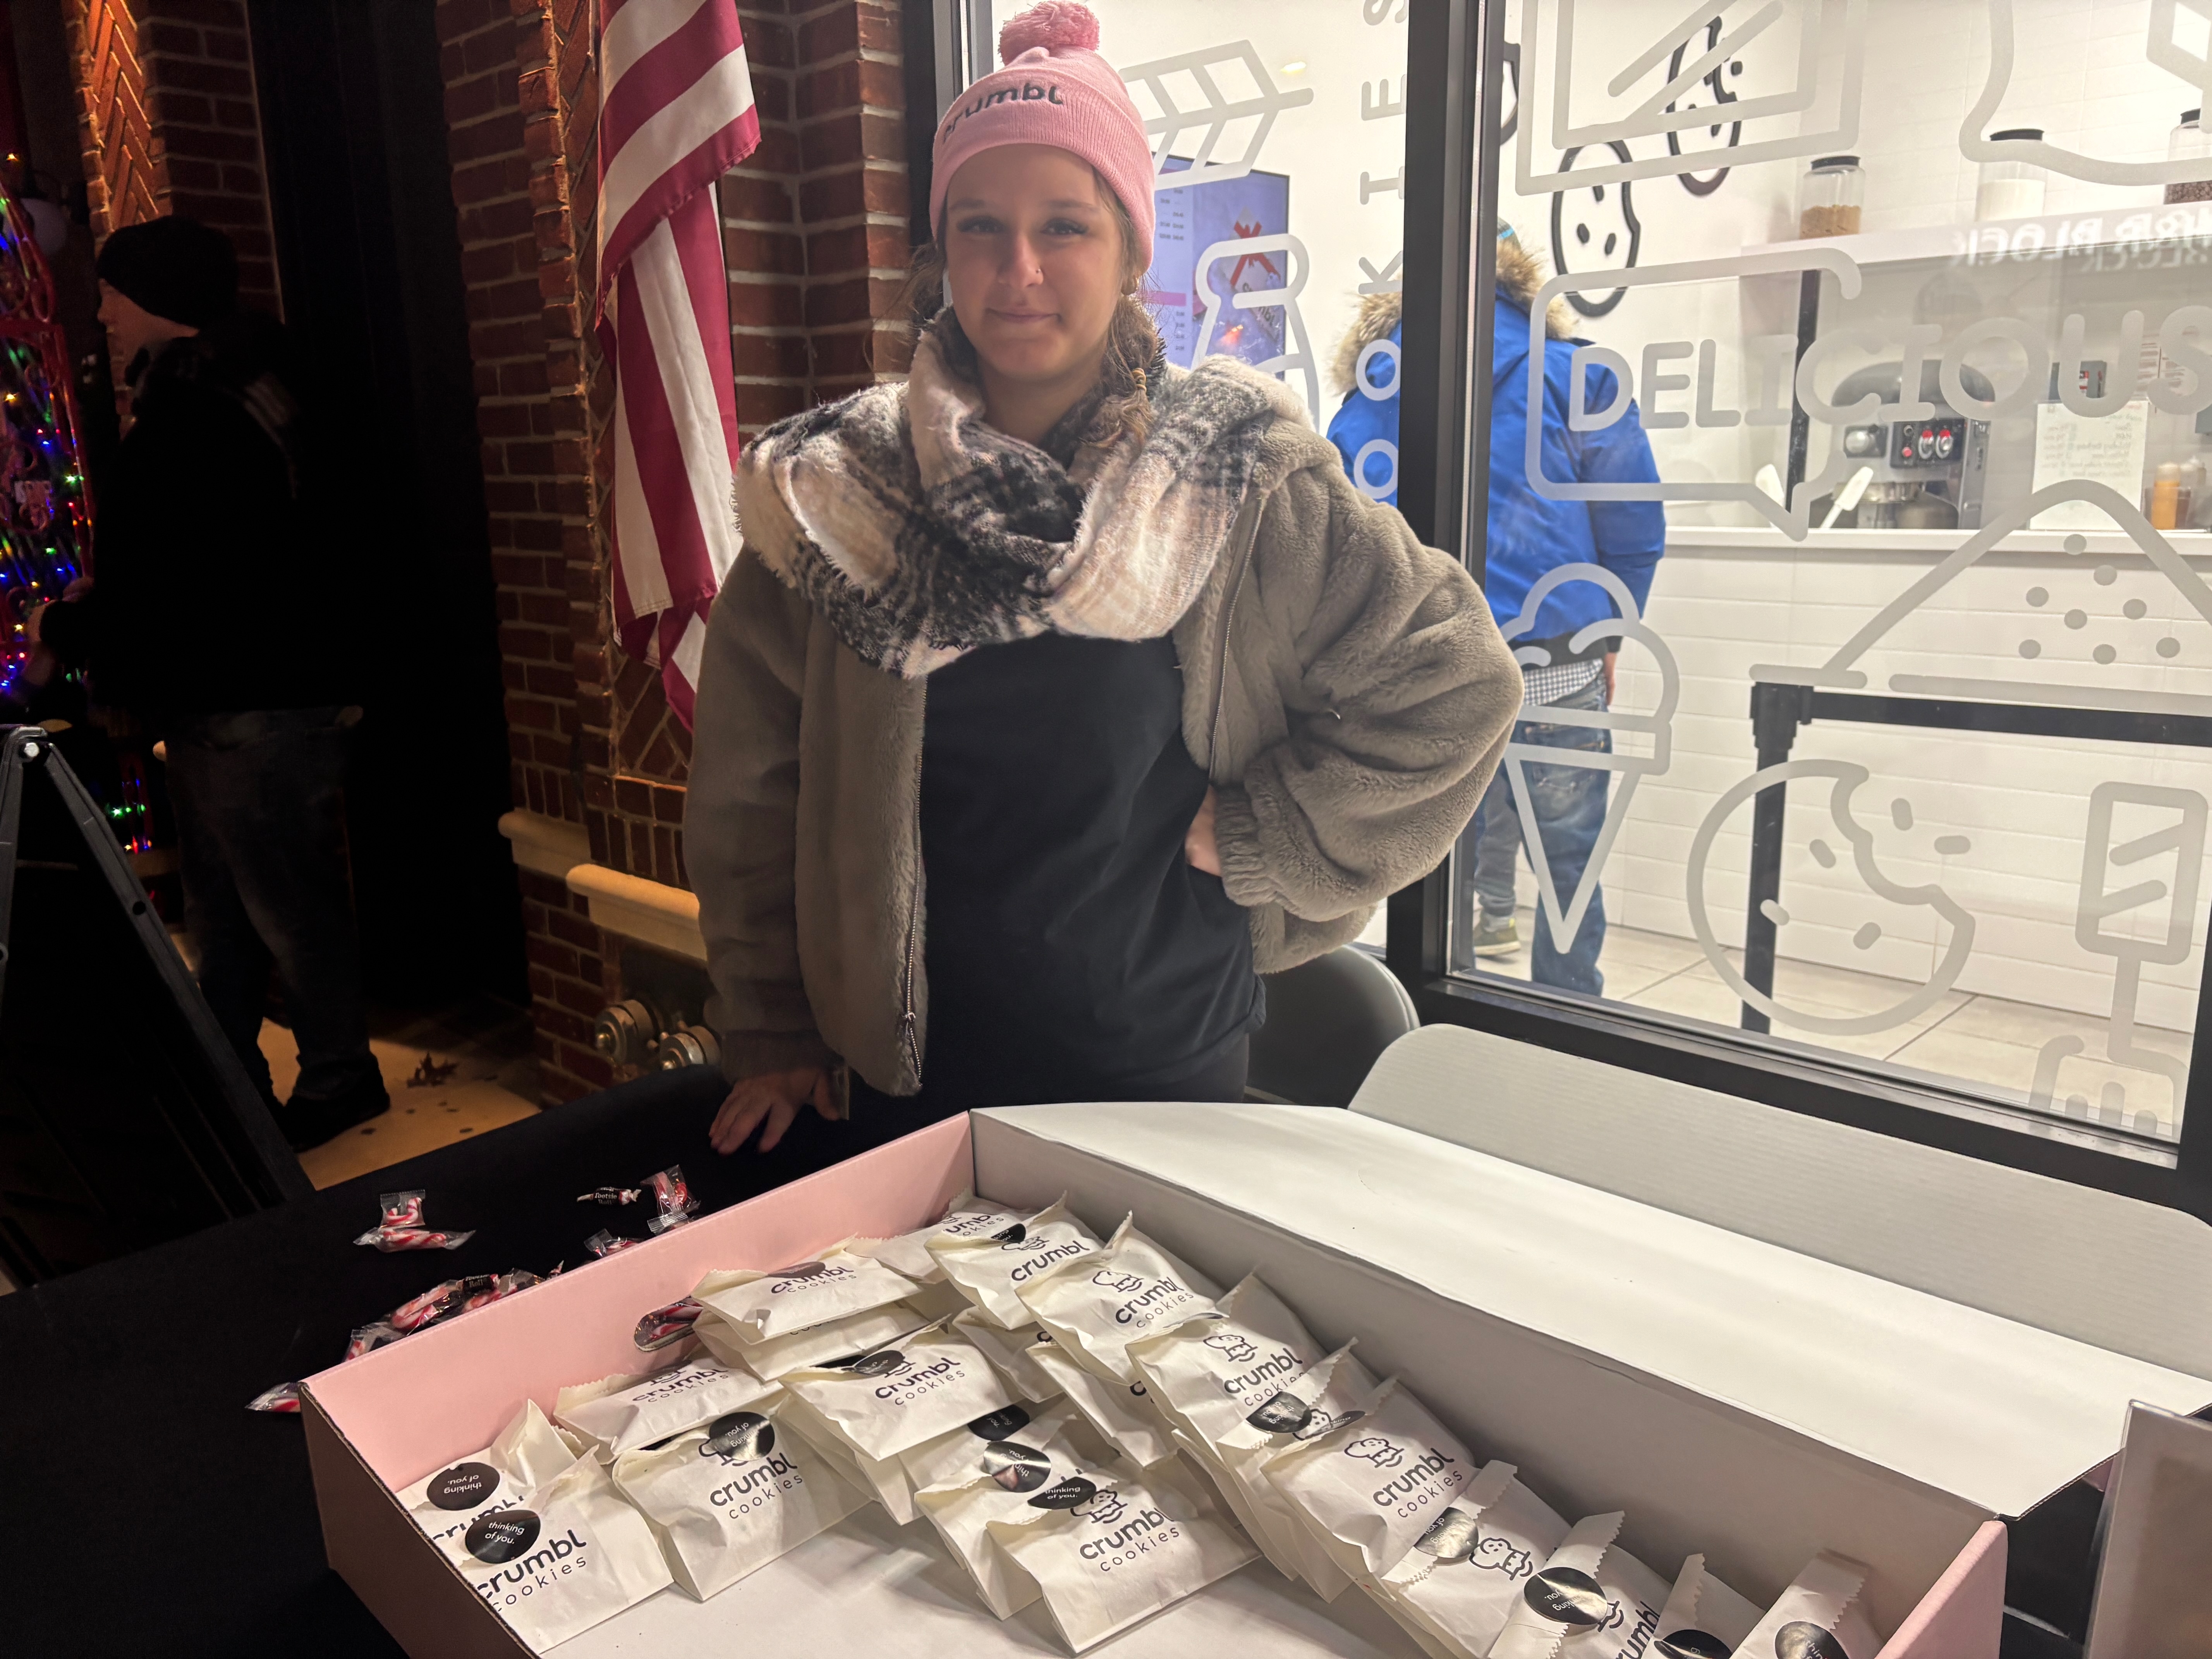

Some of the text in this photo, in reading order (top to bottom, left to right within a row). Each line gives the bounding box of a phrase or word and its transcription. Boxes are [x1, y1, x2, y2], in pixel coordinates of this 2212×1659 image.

[1354, 0, 1409, 500] OOKIES
[1568, 305, 2212, 432] DELICIOUS
[963, 1217, 1005, 1236] okies
[1011, 1240, 1090, 1281] crumbl
[771, 1266, 854, 1293] crumbl
[787, 1275, 857, 1292] cookies
[1116, 1276, 1185, 1324] crumbl
[1136, 1292, 1194, 1328] cookies
[632, 1369, 729, 1401] crumbl
[875, 1357, 961, 1399] crumbl
[895, 1370, 965, 1405] cookies
[1224, 1348, 1303, 1393] crumbl
[648, 1375, 728, 1403] cookies
[725, 1422, 749, 1437] of you.
[444, 1482, 482, 1494] thinking
[447, 1476, 467, 1485] you.
[710, 1453, 797, 1506] crumbl
[1373, 1448, 1455, 1506] crumbl
[1398, 1471, 1462, 1518] cookies
[729, 1475, 802, 1519] cookies
[489, 1521, 525, 1535] thinking
[494, 1534, 515, 1544] you.
[1436, 1518, 1445, 1526] of
[1100, 1527, 1179, 1571] cookies
[1544, 1589, 1563, 1601] you.
